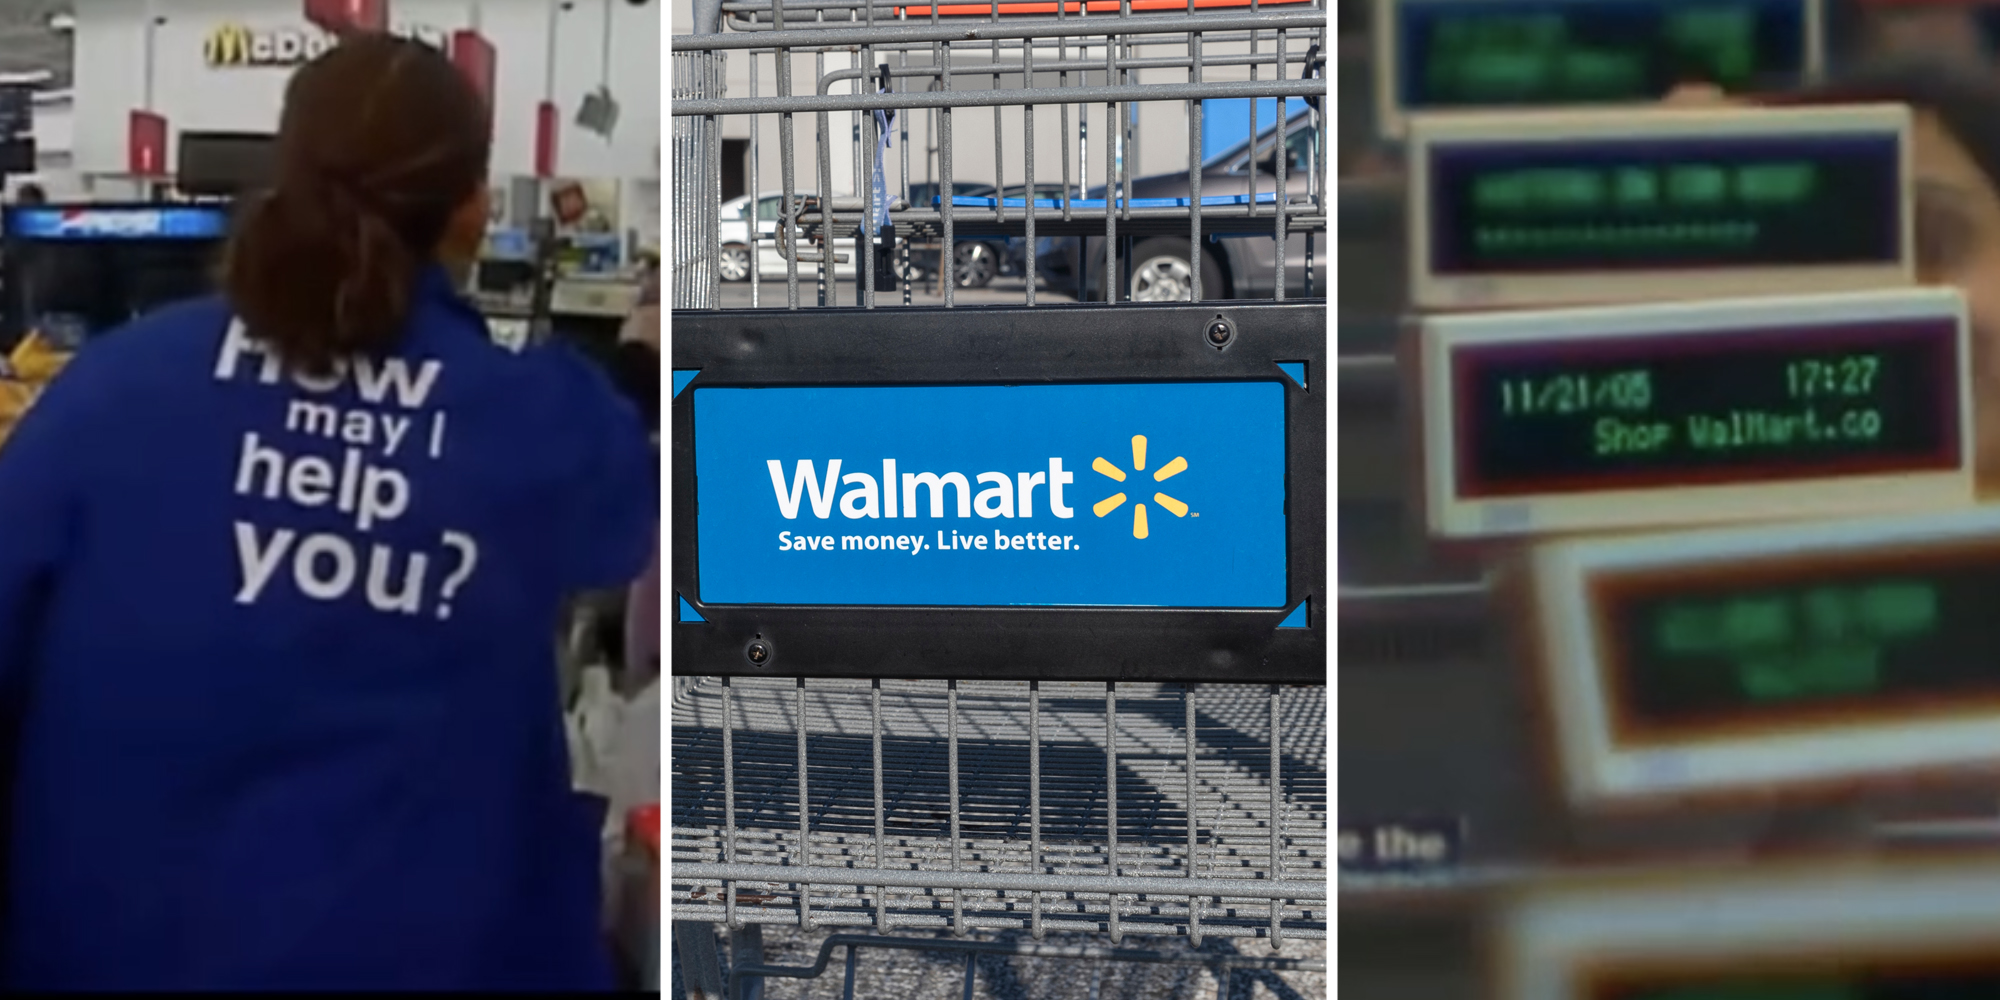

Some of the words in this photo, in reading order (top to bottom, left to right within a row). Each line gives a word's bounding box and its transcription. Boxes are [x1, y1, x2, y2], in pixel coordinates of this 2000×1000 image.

[1787, 355, 1879, 396] 17:27
[286, 400, 410, 456] may
[429, 411, 446, 458] I
[235, 432, 410, 530] help
[766, 457, 1074, 519] Walmart
[234, 520, 478, 620] you?
[778, 530, 835, 551] Save
[841, 535, 930, 556] money.
[937, 530, 989, 550] Live
[995, 529, 1080, 550] better.
[1375, 825, 1447, 860] the
